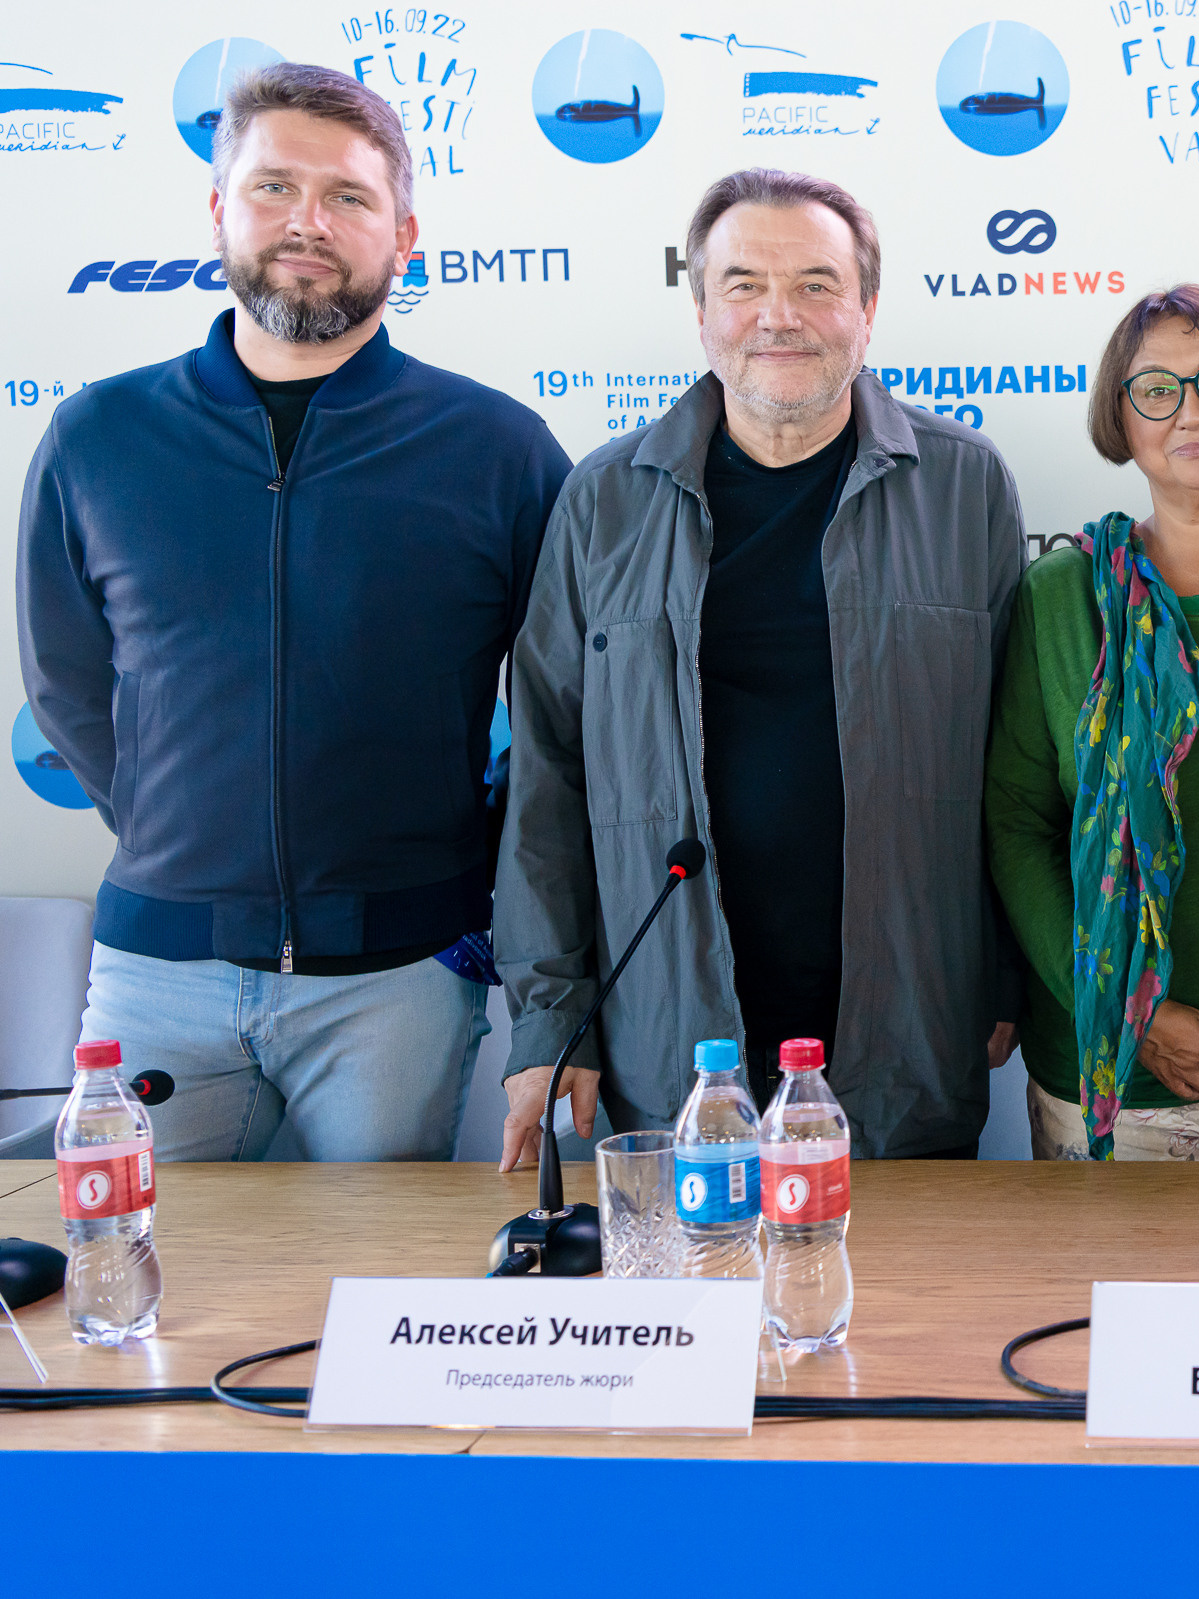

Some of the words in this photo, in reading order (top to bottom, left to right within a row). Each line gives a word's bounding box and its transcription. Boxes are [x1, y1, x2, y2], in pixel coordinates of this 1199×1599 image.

[743, 106, 828, 123] PACIFIC
[418, 145, 464, 177] AL
[67, 259, 228, 294] FESC
[440, 248, 570, 283] ВМТП
[924, 271, 1126, 297] VLADNEWS
[533, 370, 594, 397] 19th
[606, 371, 704, 387] Internati
[874, 364, 1087, 399] РИДИАНЫ
[607, 393, 649, 408] Film
[607, 415, 627, 430] of
[389, 1316, 538, 1345] Алексей
[548, 1317, 694, 1346] Учитель
[445, 1369, 576, 1391] Председатель
[580, 1373, 634, 1391] жюри
